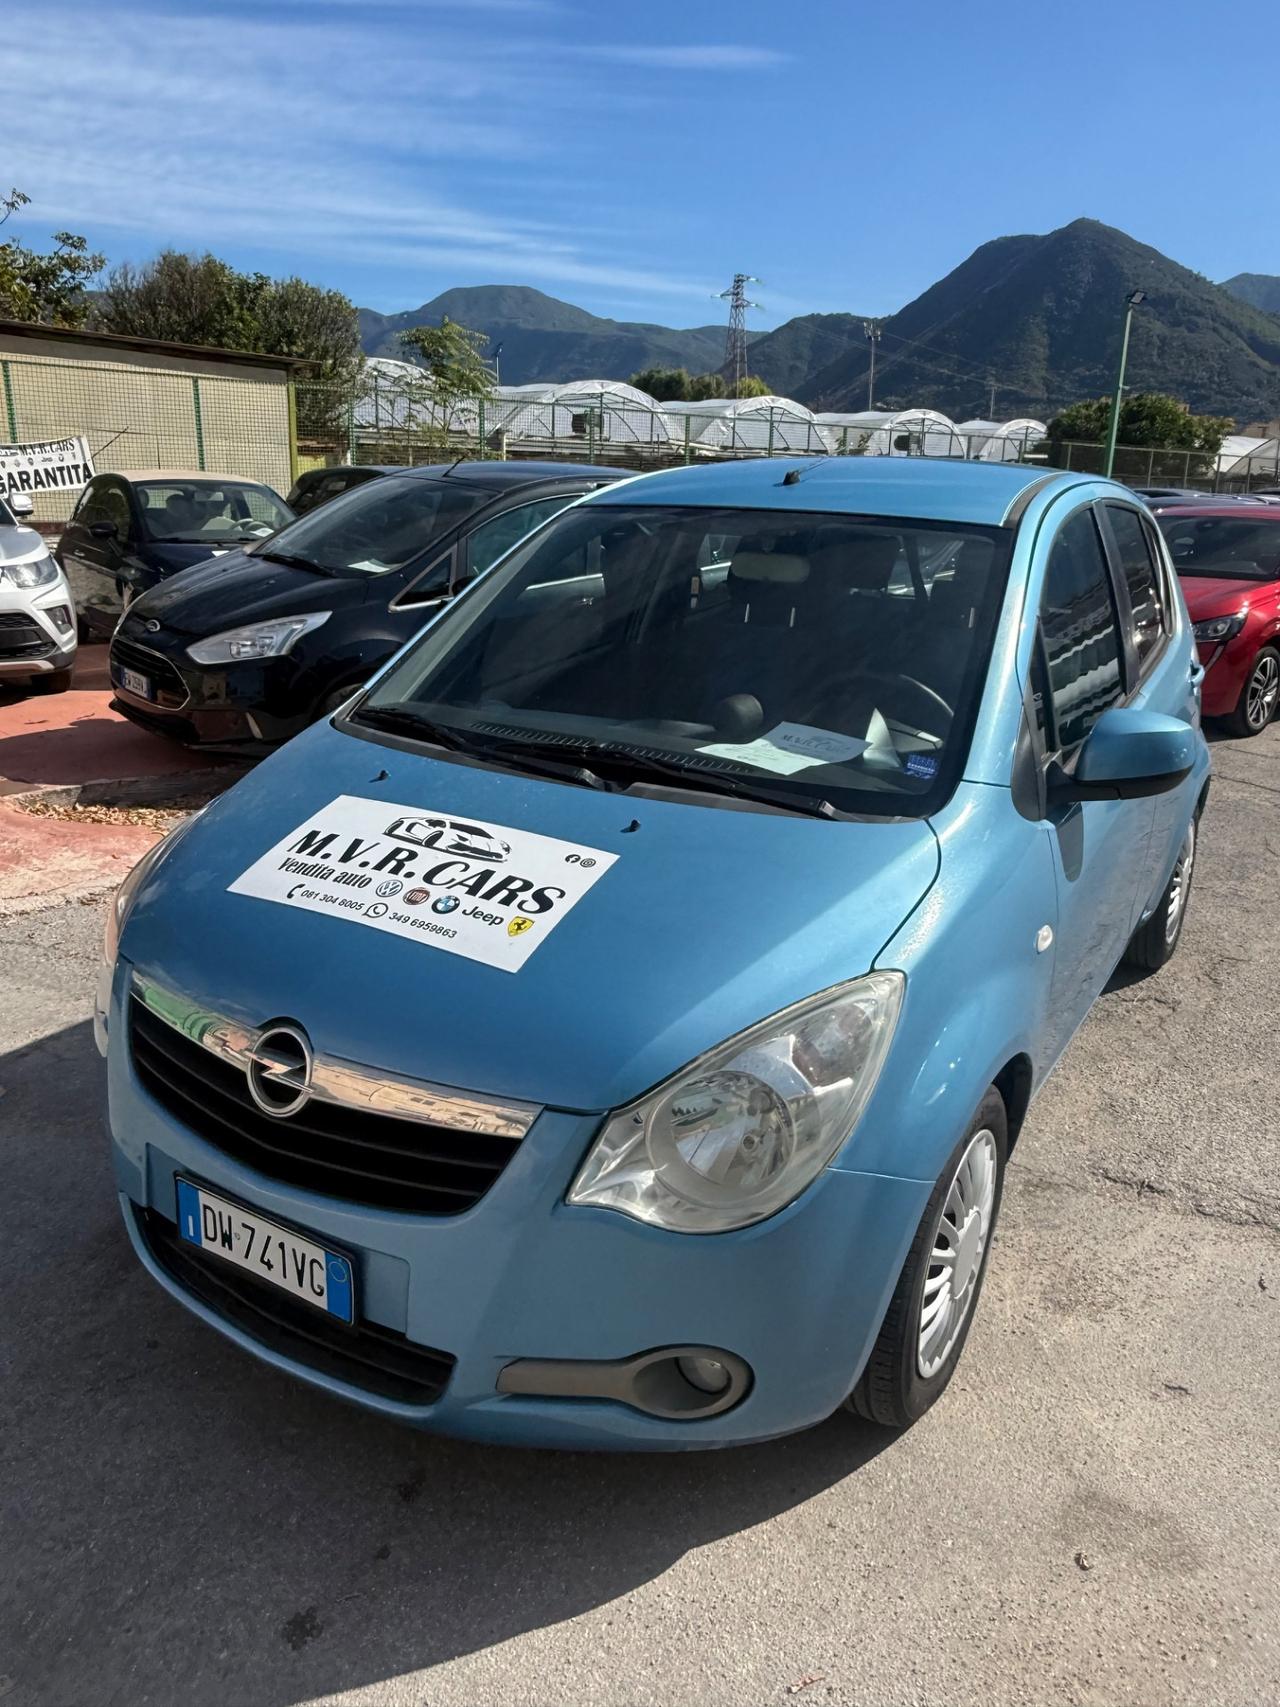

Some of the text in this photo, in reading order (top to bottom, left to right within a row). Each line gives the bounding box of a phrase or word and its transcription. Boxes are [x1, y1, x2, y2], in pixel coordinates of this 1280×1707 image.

[278, 857, 373, 889] Vendita auto
[300, 889, 365, 911] 081 304 6005
[388, 912, 458, 939] 349 6959863
[461, 906, 505, 926] Jeep
